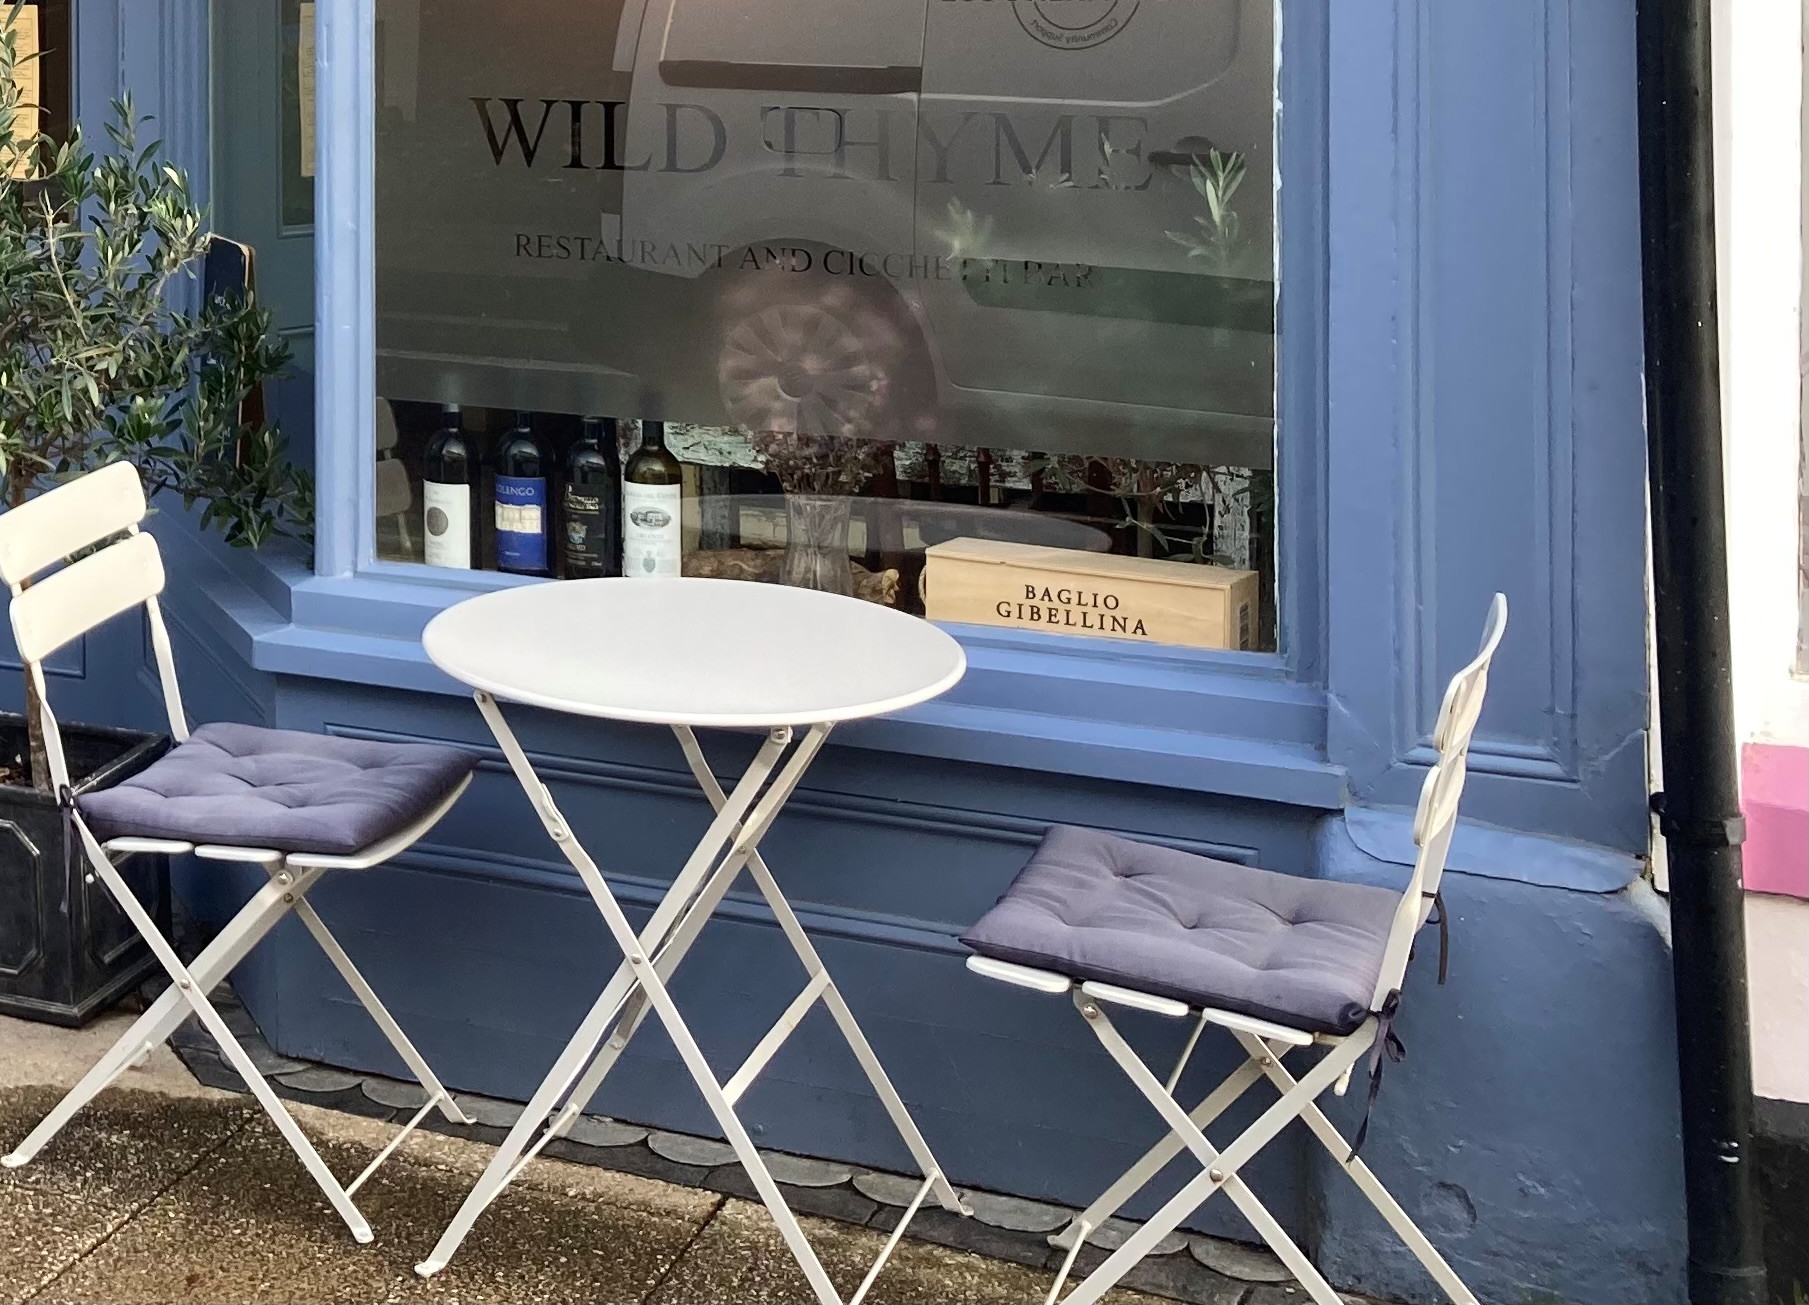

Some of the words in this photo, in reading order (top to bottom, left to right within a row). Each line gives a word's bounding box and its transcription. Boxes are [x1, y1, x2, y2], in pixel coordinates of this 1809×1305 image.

[468, 95, 728, 175] WILD
[760, 103, 1156, 192] THYME
[513, 232, 728, 271] RESTAURANT
[738, 247, 813, 274] AND
[1024, 583, 1120, 611] BAGLIO
[995, 600, 1149, 637] GIBELLINA
